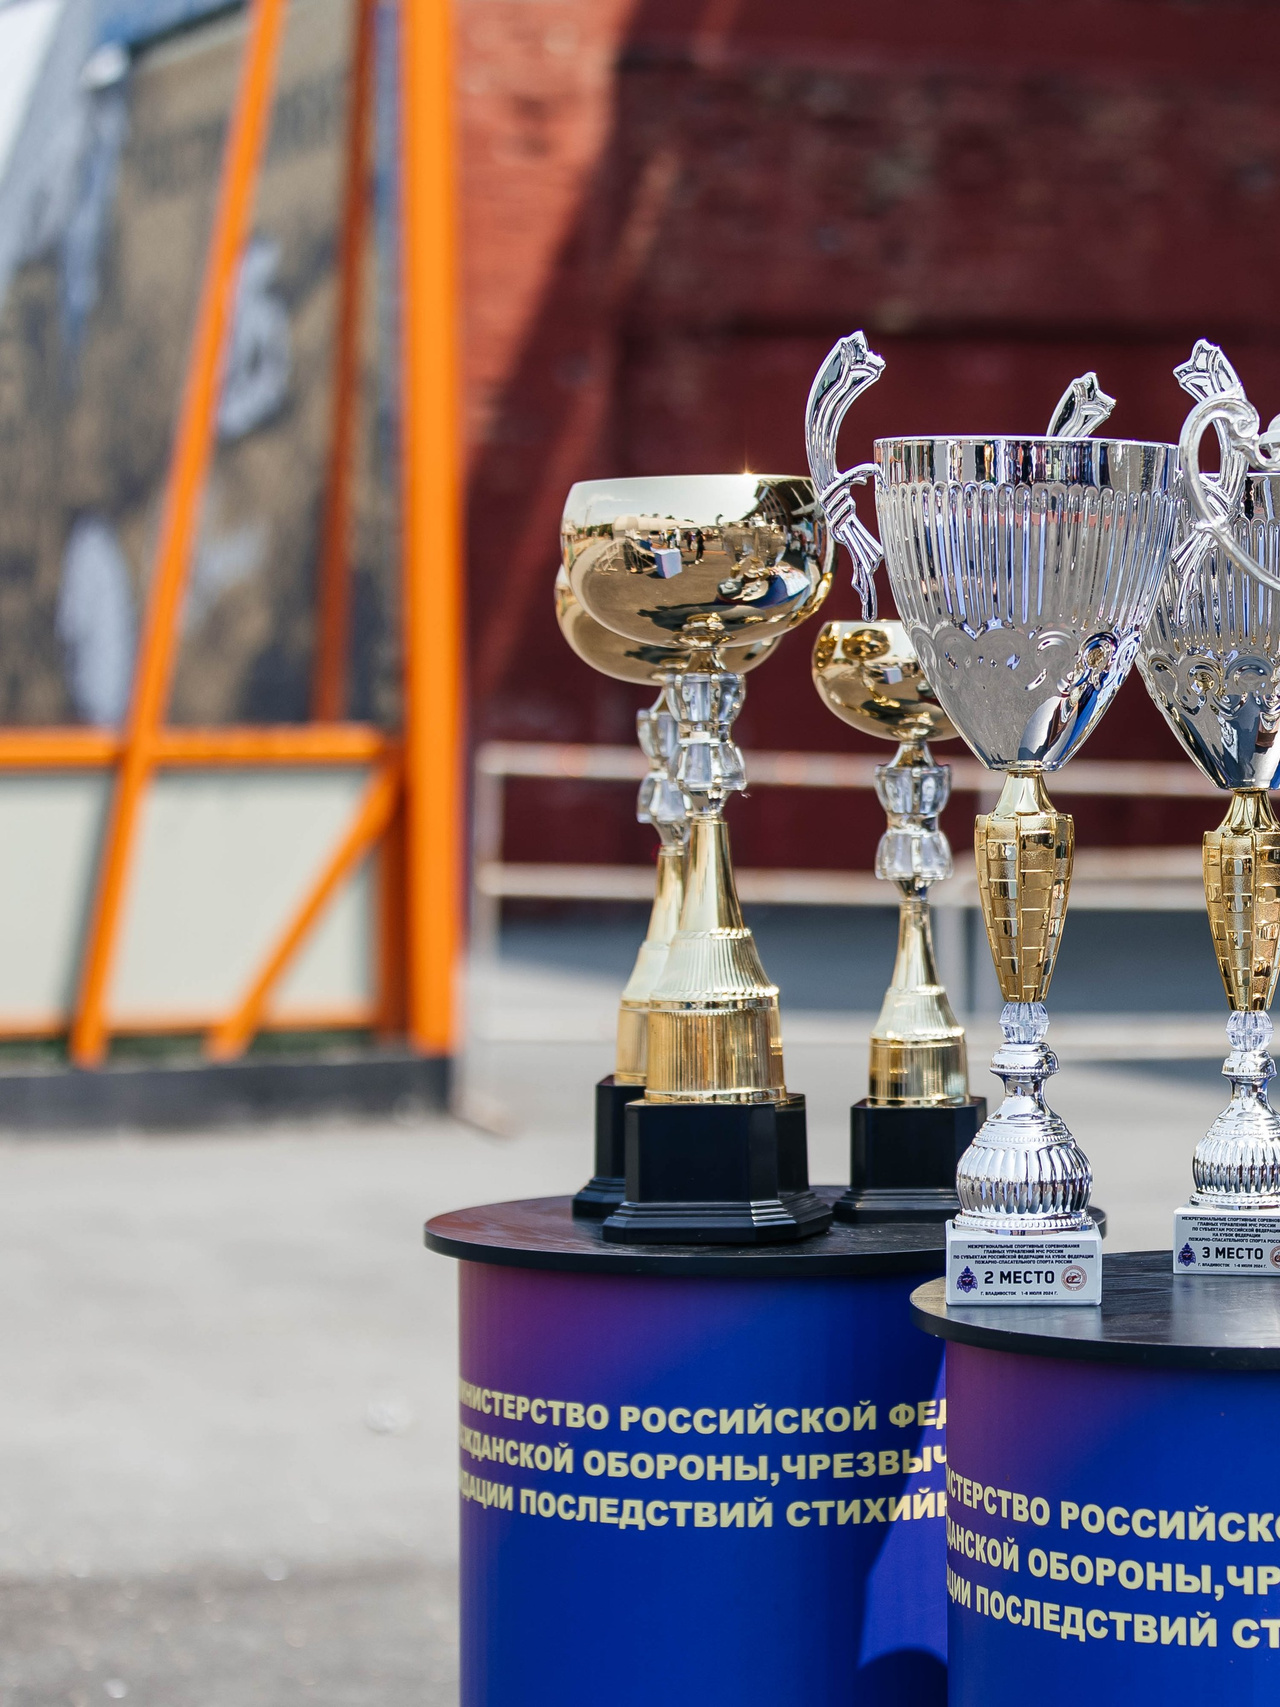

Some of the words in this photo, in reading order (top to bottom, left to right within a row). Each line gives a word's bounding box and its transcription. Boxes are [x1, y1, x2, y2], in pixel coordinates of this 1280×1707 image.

[1202, 1247, 1210, 1258] 3
[1215, 1247, 1263, 1260] МЕСТО
[984, 1271, 994, 1284] 2
[1000, 1271, 1055, 1284] МЕСТО
[621, 1400, 876, 1434] РОССИЙСКОЙ
[521, 1489, 772, 1530] ПОСЛЕДСТВИЙ
[977, 1588, 1218, 1647] ПОСЛЕДСТВИЙ
